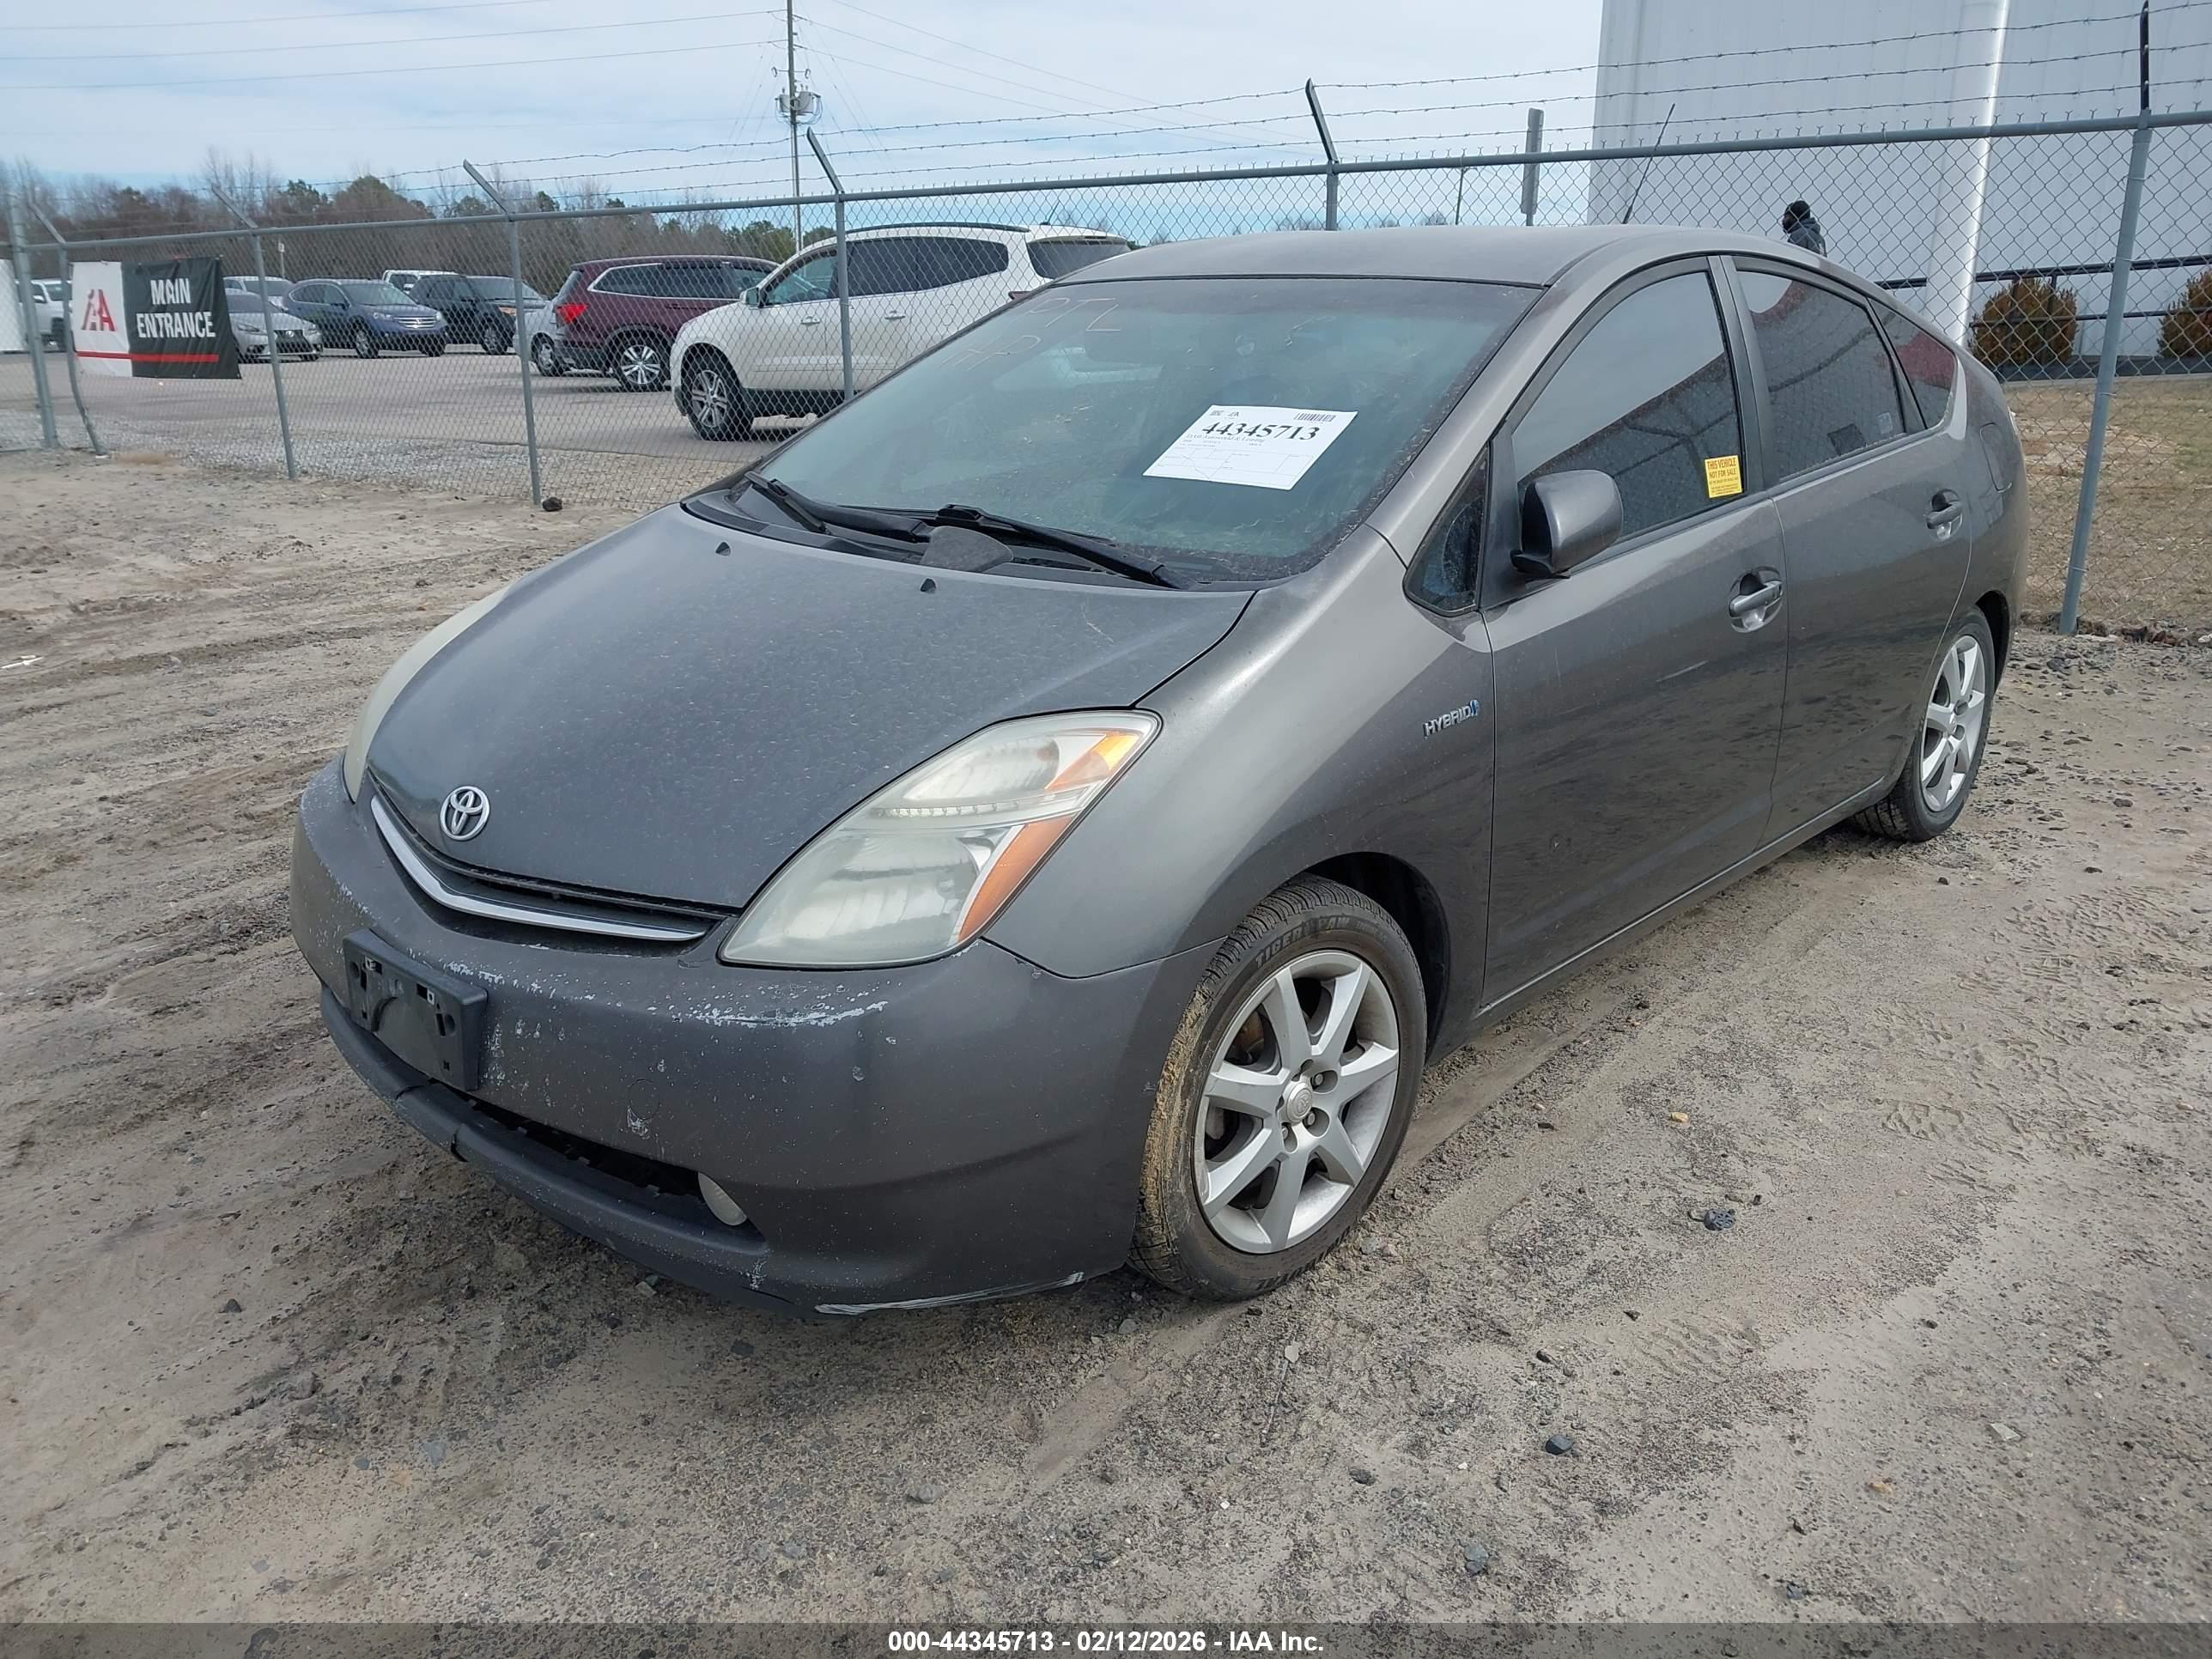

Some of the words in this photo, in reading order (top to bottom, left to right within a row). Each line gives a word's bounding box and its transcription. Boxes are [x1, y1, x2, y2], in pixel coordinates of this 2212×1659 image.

[150, 277, 191, 305] MAIN
[136, 311, 216, 338] ENTRANCE
[1202, 422, 1321, 441] 44345713
[1717, 470, 1726, 478] FOR
[1424, 705, 1471, 736] HYBRID
[1255, 926, 1304, 970] TIGER
[1320, 915, 1351, 931] PAW
